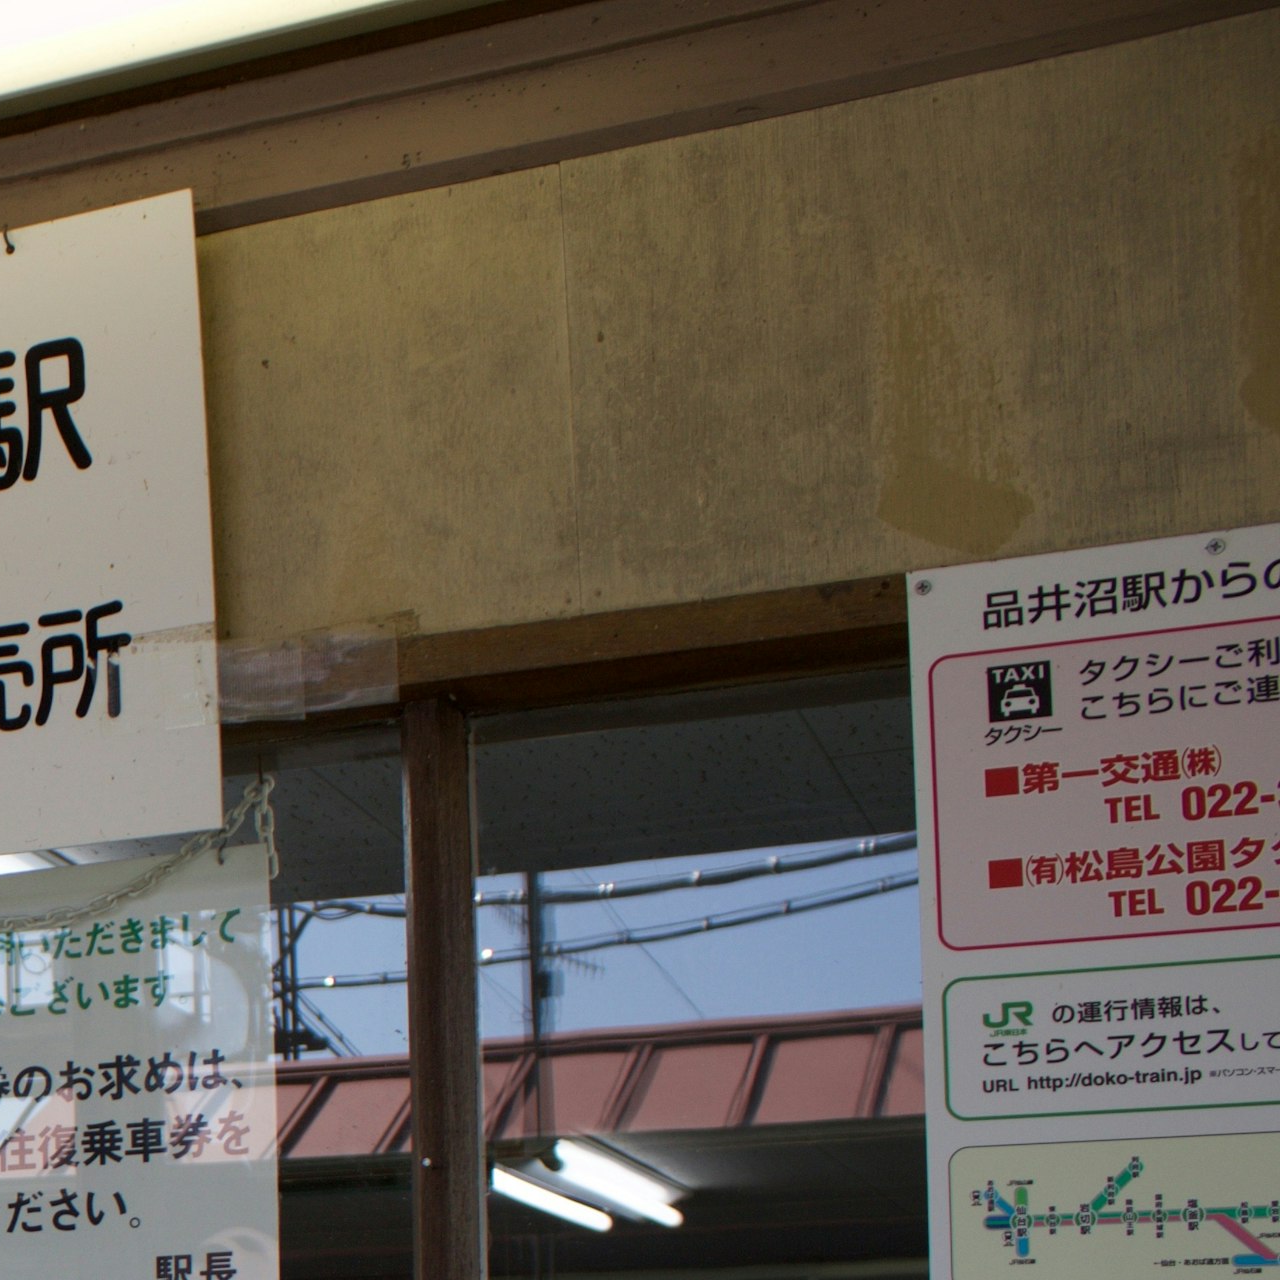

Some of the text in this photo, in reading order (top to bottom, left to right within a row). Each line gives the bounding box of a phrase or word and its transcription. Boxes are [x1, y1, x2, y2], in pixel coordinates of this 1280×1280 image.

[992, 664, 1046, 684] TAXI
[984, 725, 1062, 746] タクシー
[1105, 780, 1280, 823] TEL 022-
[1026, 836, 1280, 886] (有)松島公園タ
[1109, 889, 1165, 917] TEL
[982, 995, 1223, 1029] JR の運行情報は、
[982, 1078, 1019, 1093] URL
[1027, 1067, 1202, 1091] http://doko-train.jp
